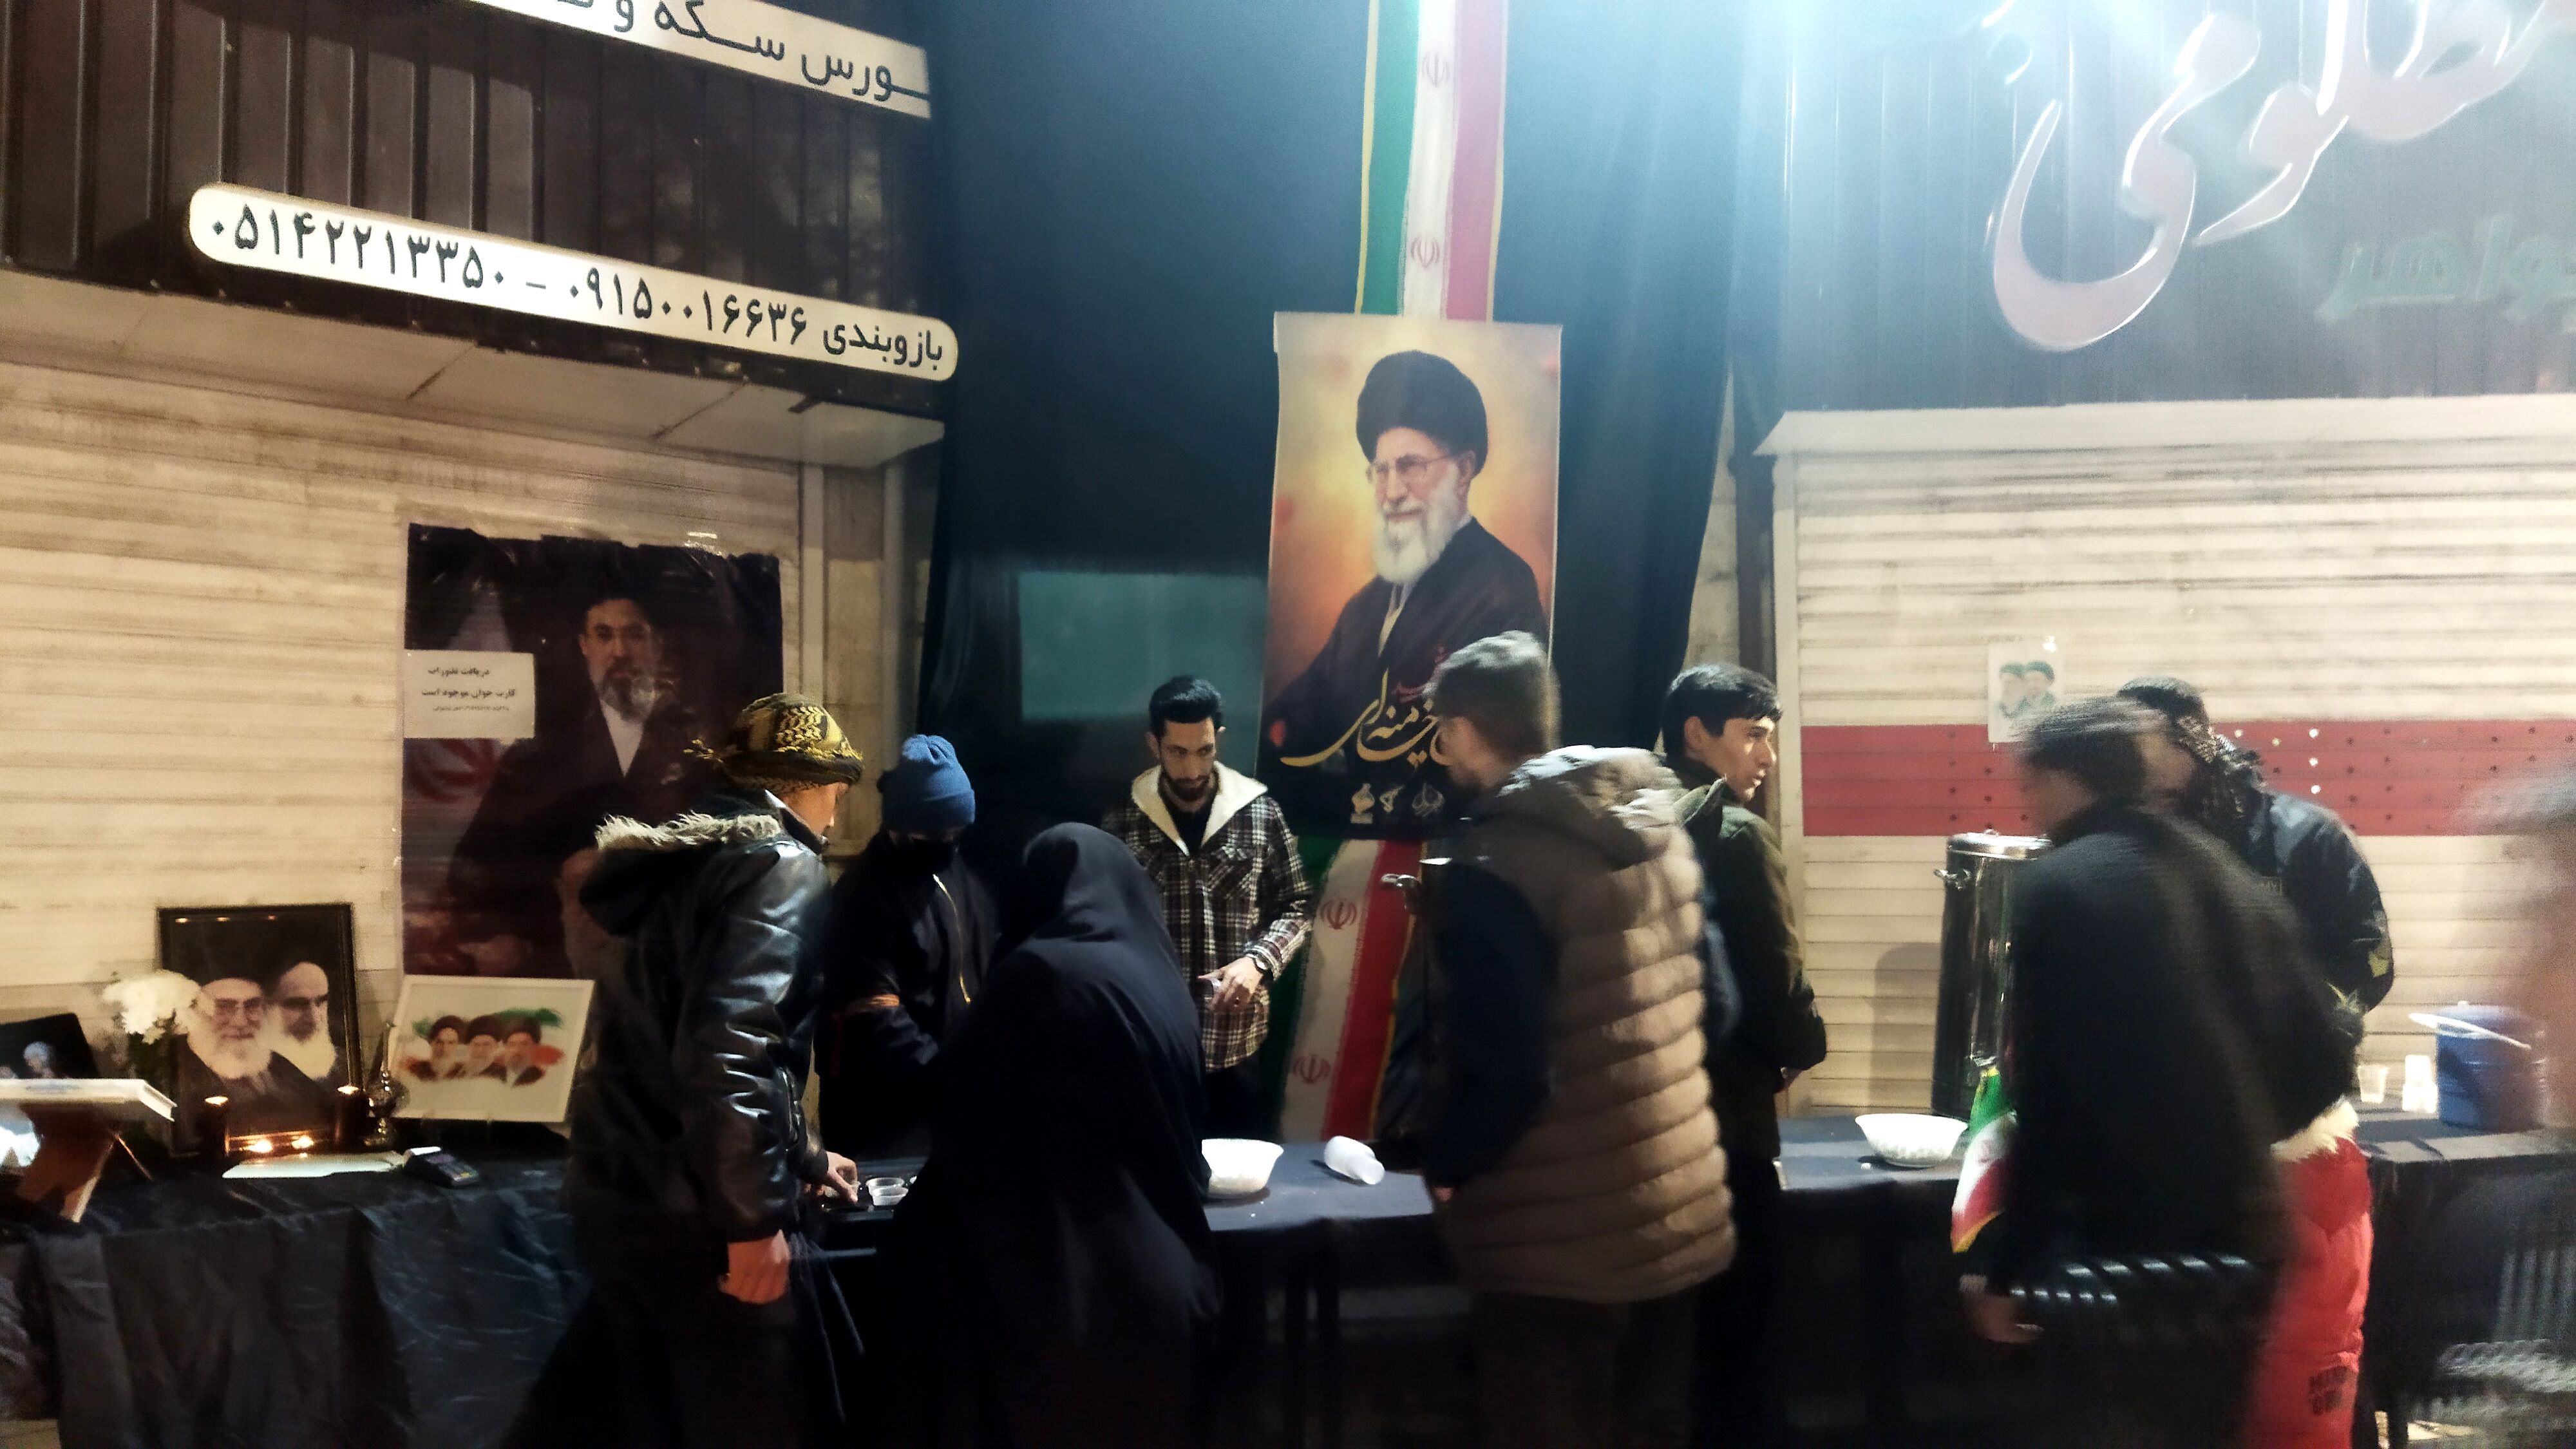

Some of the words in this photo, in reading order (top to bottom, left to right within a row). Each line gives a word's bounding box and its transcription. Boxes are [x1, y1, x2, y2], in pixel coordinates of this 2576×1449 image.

[614, 0, 634, 32] و
[654, 0, 784, 60] سکه
[800, 55, 930, 102] ورس
[213, 204, 504, 289] ۰۵۱۴۲۲۱۳۳۵۰
[569, 267, 807, 345] ۰۹۱۵۰۰۱۶۶۳۶
[822, 323, 943, 370] بازوبندی
